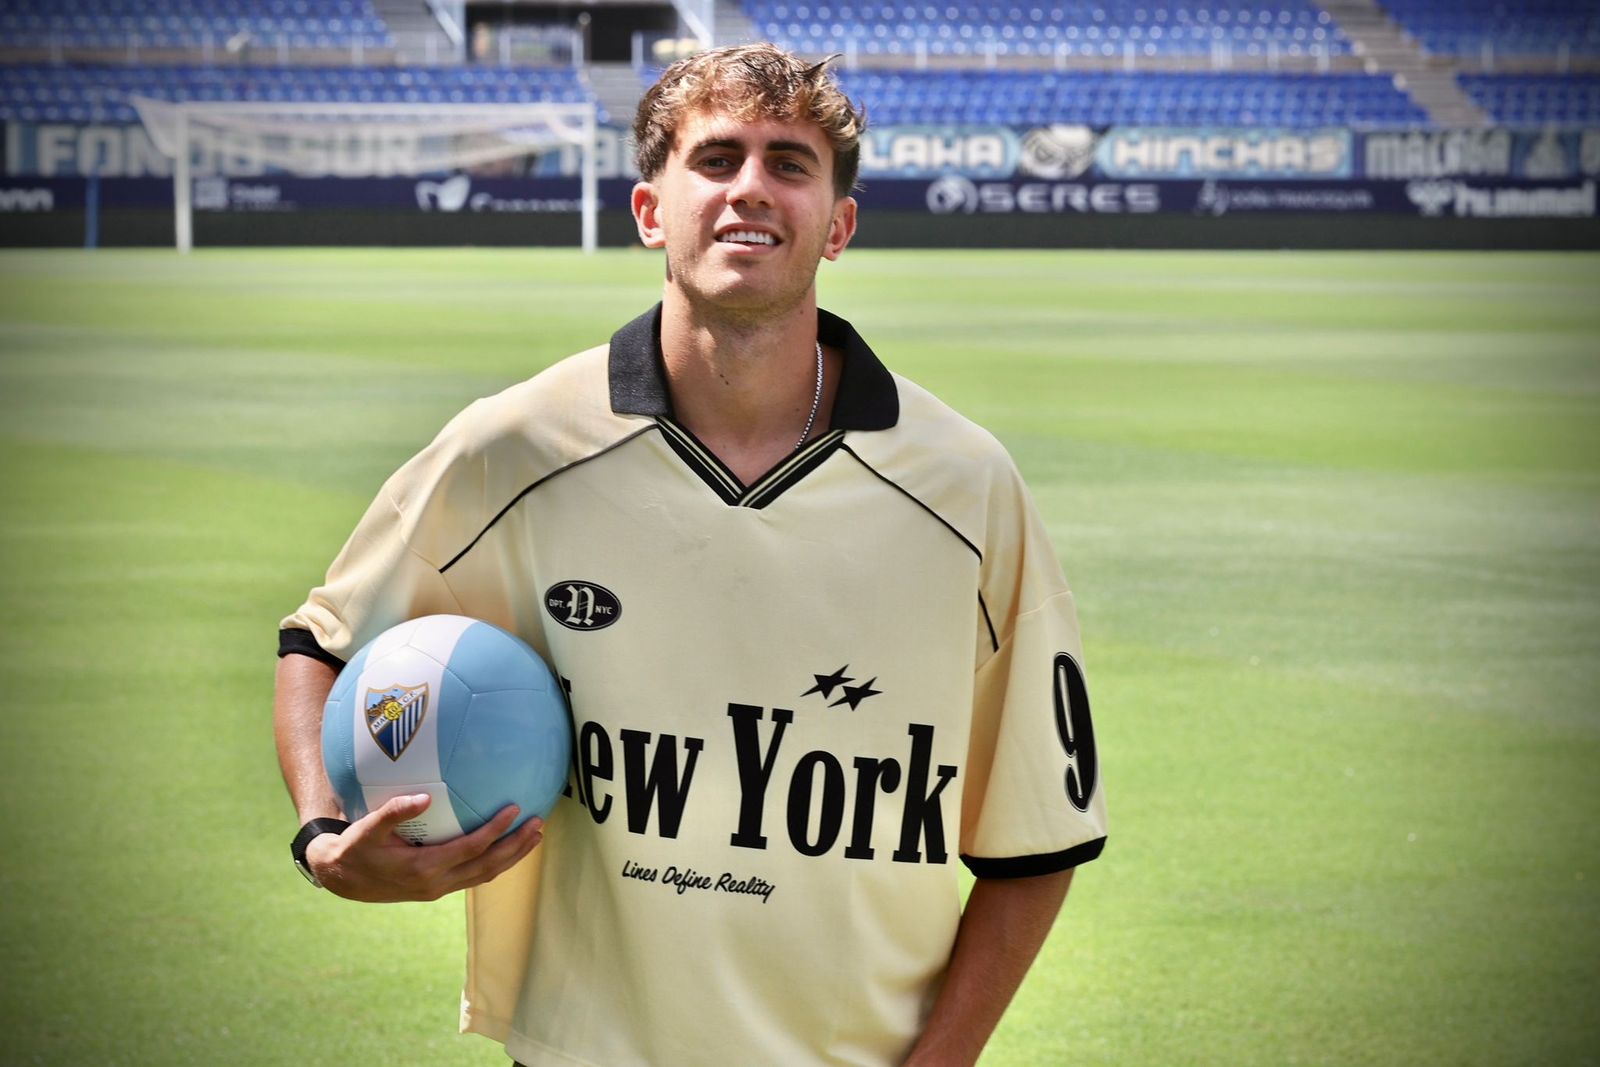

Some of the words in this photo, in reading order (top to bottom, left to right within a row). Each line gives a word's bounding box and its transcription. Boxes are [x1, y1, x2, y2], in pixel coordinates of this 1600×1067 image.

[1112, 133, 1342, 174] HINCHAS
[978, 182, 1160, 214] SERES
[1454, 180, 1597, 218] hummel
[595, 605, 613, 615] NYC
[1052, 652, 1099, 812] 9
[727, 702, 958, 865] York
[622, 860, 658, 882] Lines
[662, 866, 713, 895] Define
[714, 872, 776, 904] Reality
